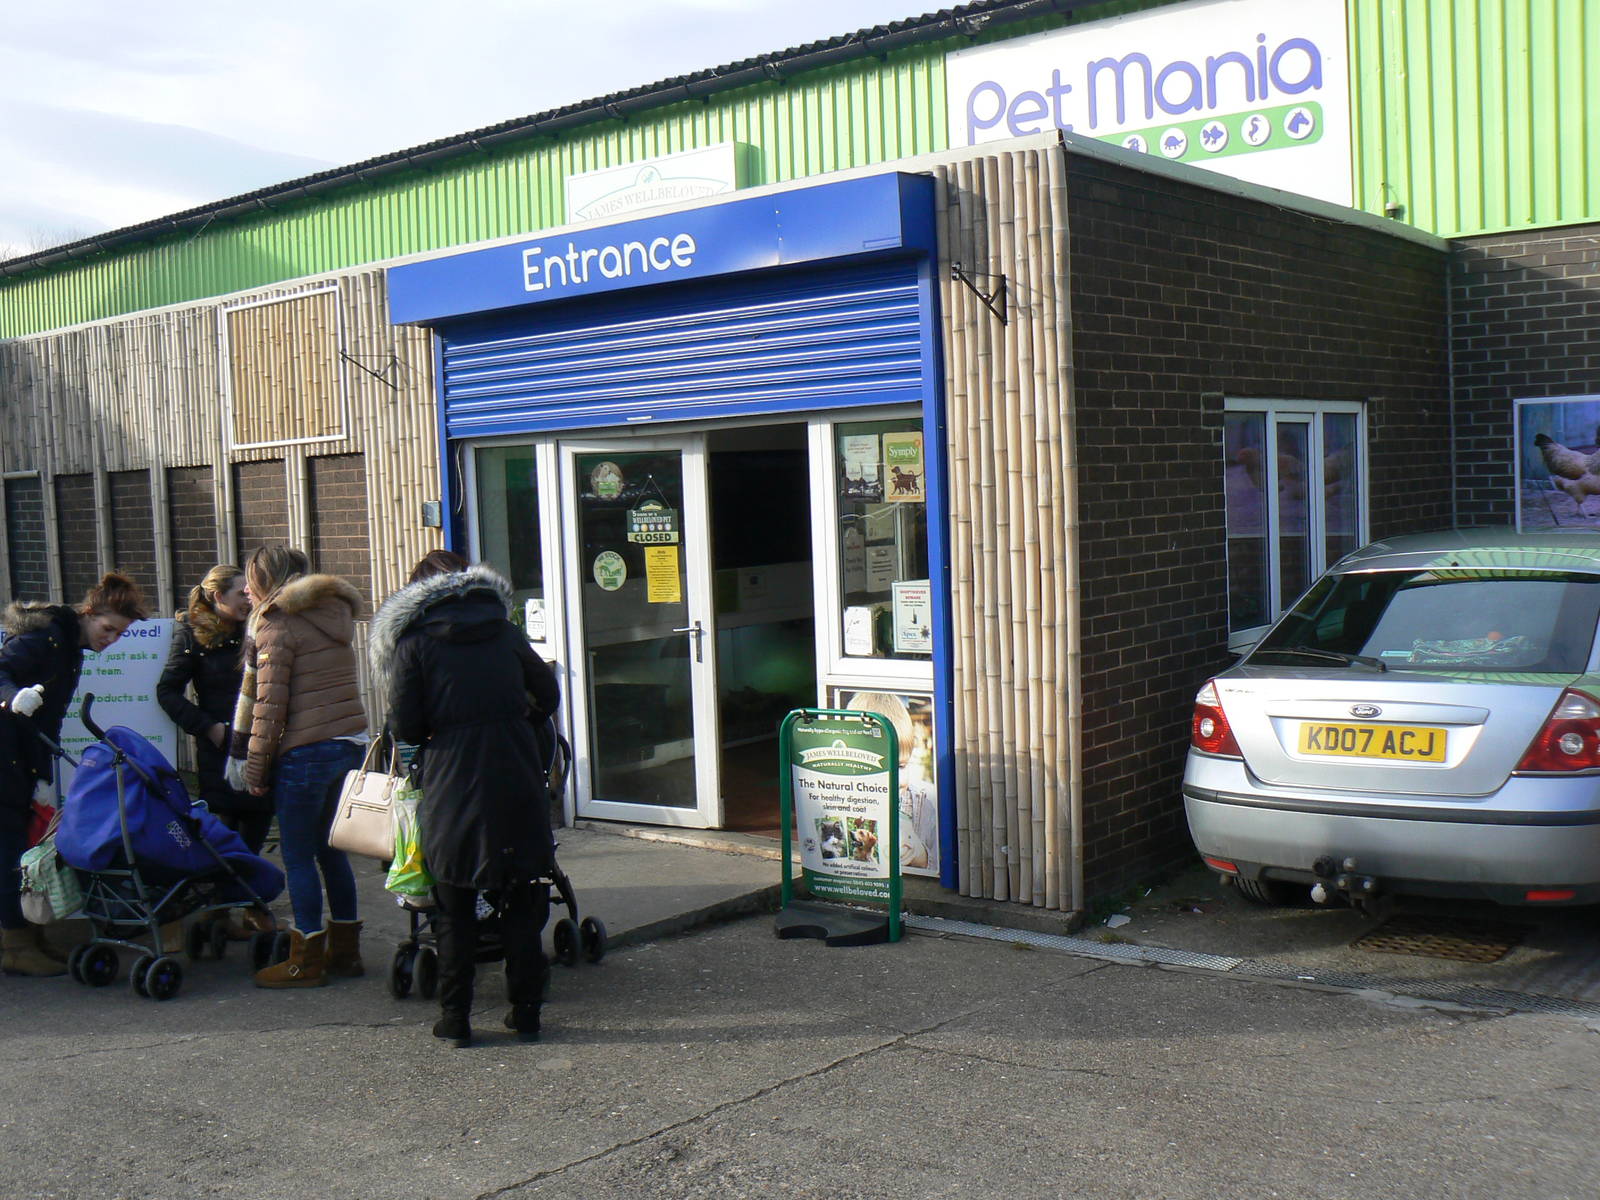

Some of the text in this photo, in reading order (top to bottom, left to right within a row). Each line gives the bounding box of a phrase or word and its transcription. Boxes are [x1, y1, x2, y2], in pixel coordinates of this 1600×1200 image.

[587, 197, 623, 221] JAMES
[521, 232, 697, 293] Entrance
[888, 446, 918, 457] Symply
[634, 533, 672, 542] CLOSED
[121, 625, 161, 638] oved!
[106, 652, 126, 662] just
[129, 651, 148, 660] ask
[96, 668, 124, 676] team.
[1307, 726, 1435, 757] KD07 ACJ
[806, 749, 878, 762] JAMES WELLBELOVED
[799, 779, 888, 794] The Natural Choice
[820, 793, 845, 804] healthy
[847, 795, 880, 806] digestion,
[837, 804, 851, 812] and
